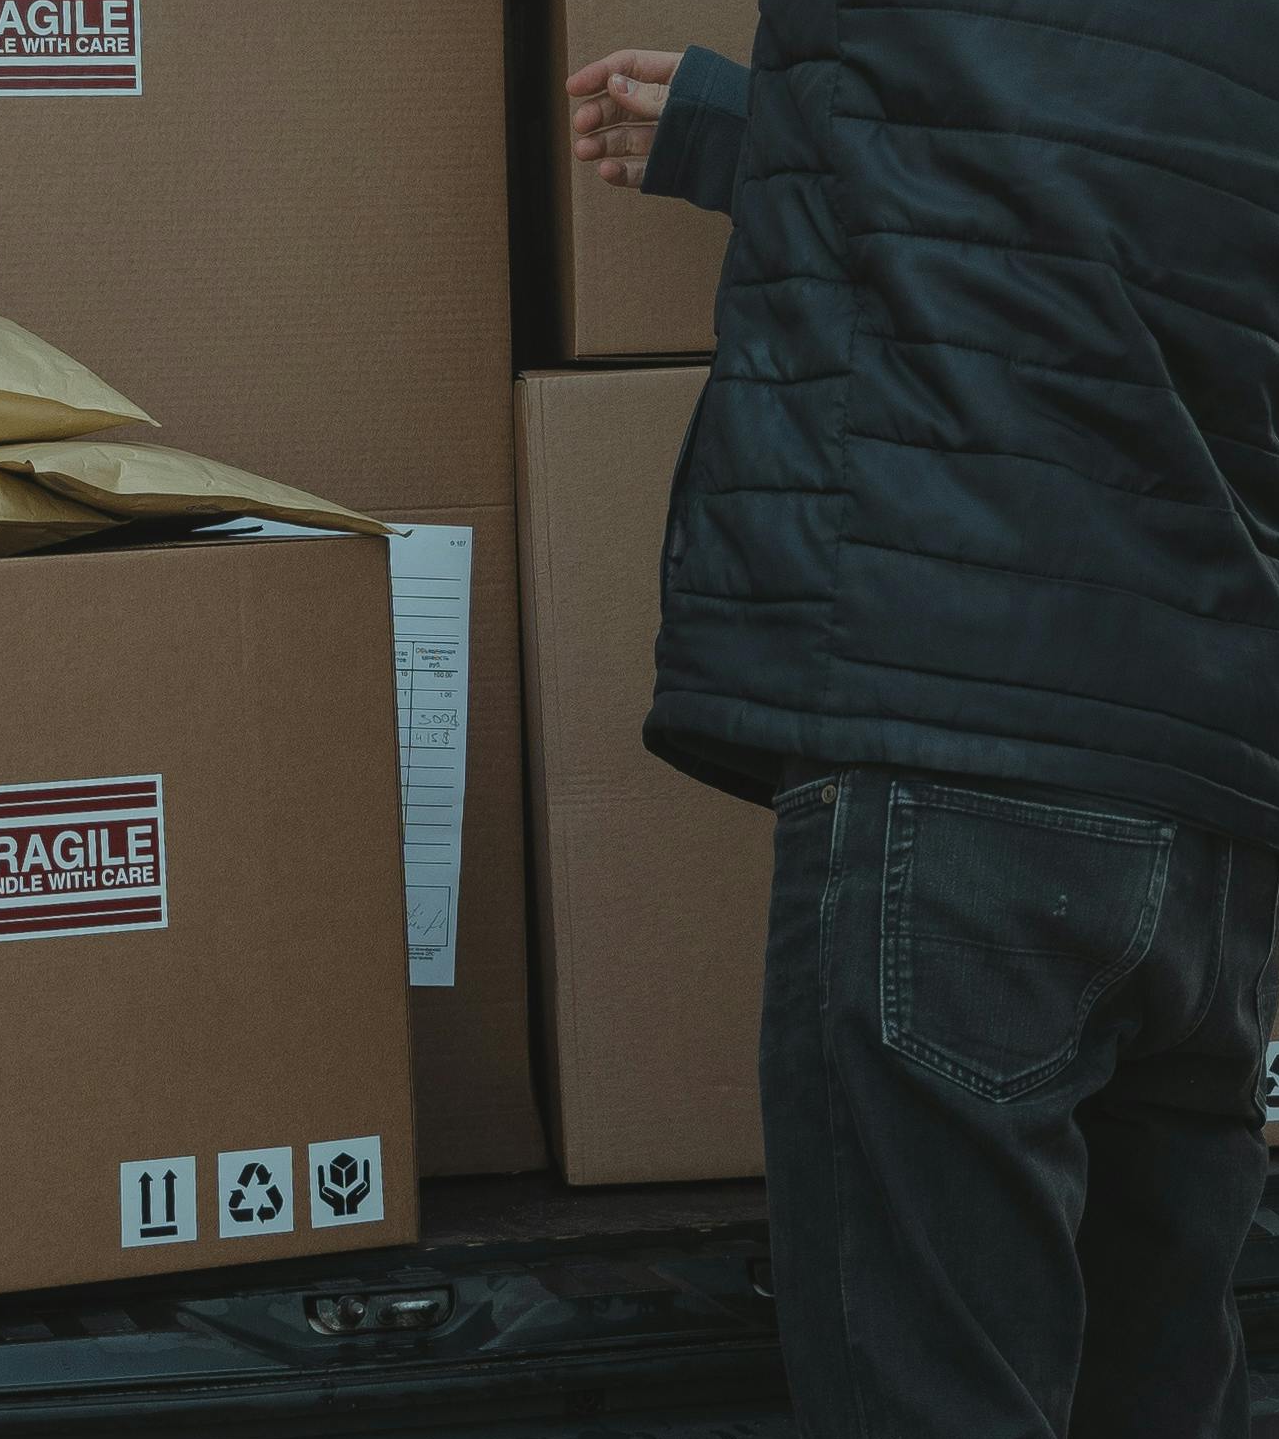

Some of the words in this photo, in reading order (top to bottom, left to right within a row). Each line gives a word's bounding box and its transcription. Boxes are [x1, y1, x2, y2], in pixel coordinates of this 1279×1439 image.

[22, 37, 71, 54] WITH
[75, 37, 130, 54] CARE
[48, 870, 97, 891] WITH
[101, 865, 155, 887] CARE
